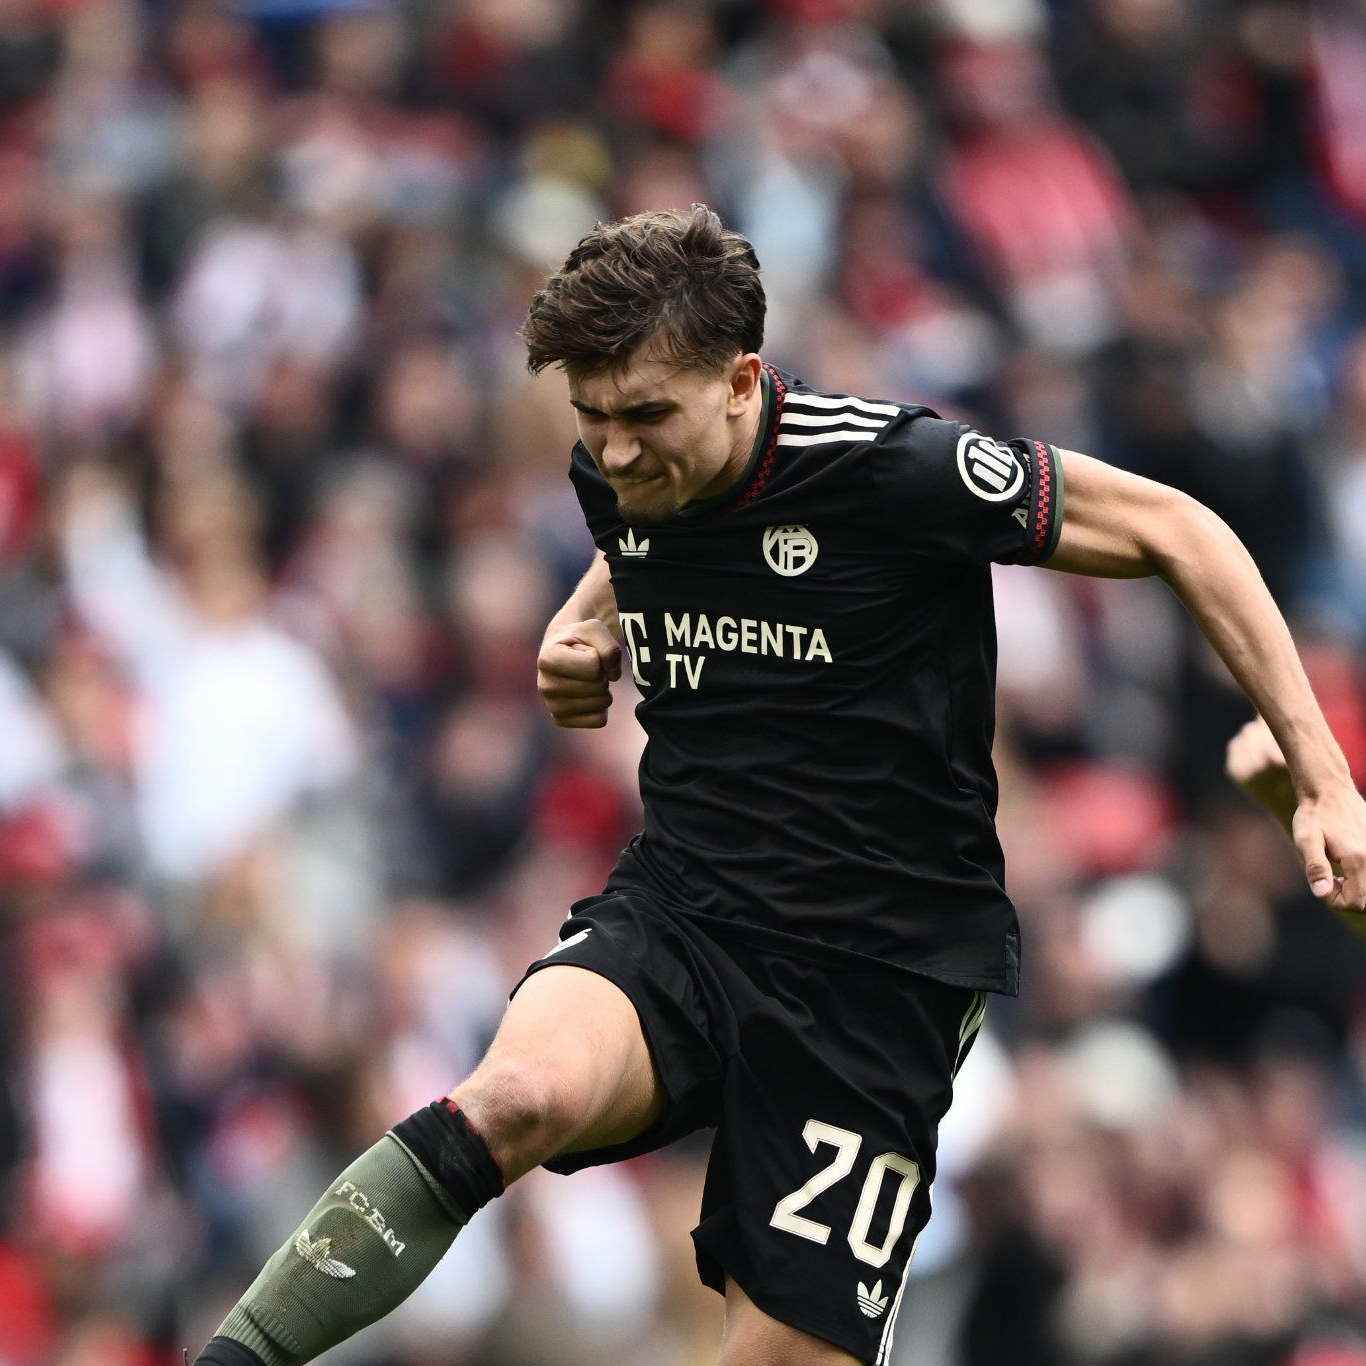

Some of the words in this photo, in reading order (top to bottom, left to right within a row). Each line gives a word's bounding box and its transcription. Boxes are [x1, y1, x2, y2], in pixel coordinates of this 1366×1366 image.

[664, 612, 833, 663] MAGENTA
[665, 653, 706, 690] TV
[769, 1118, 921, 1269] 20
